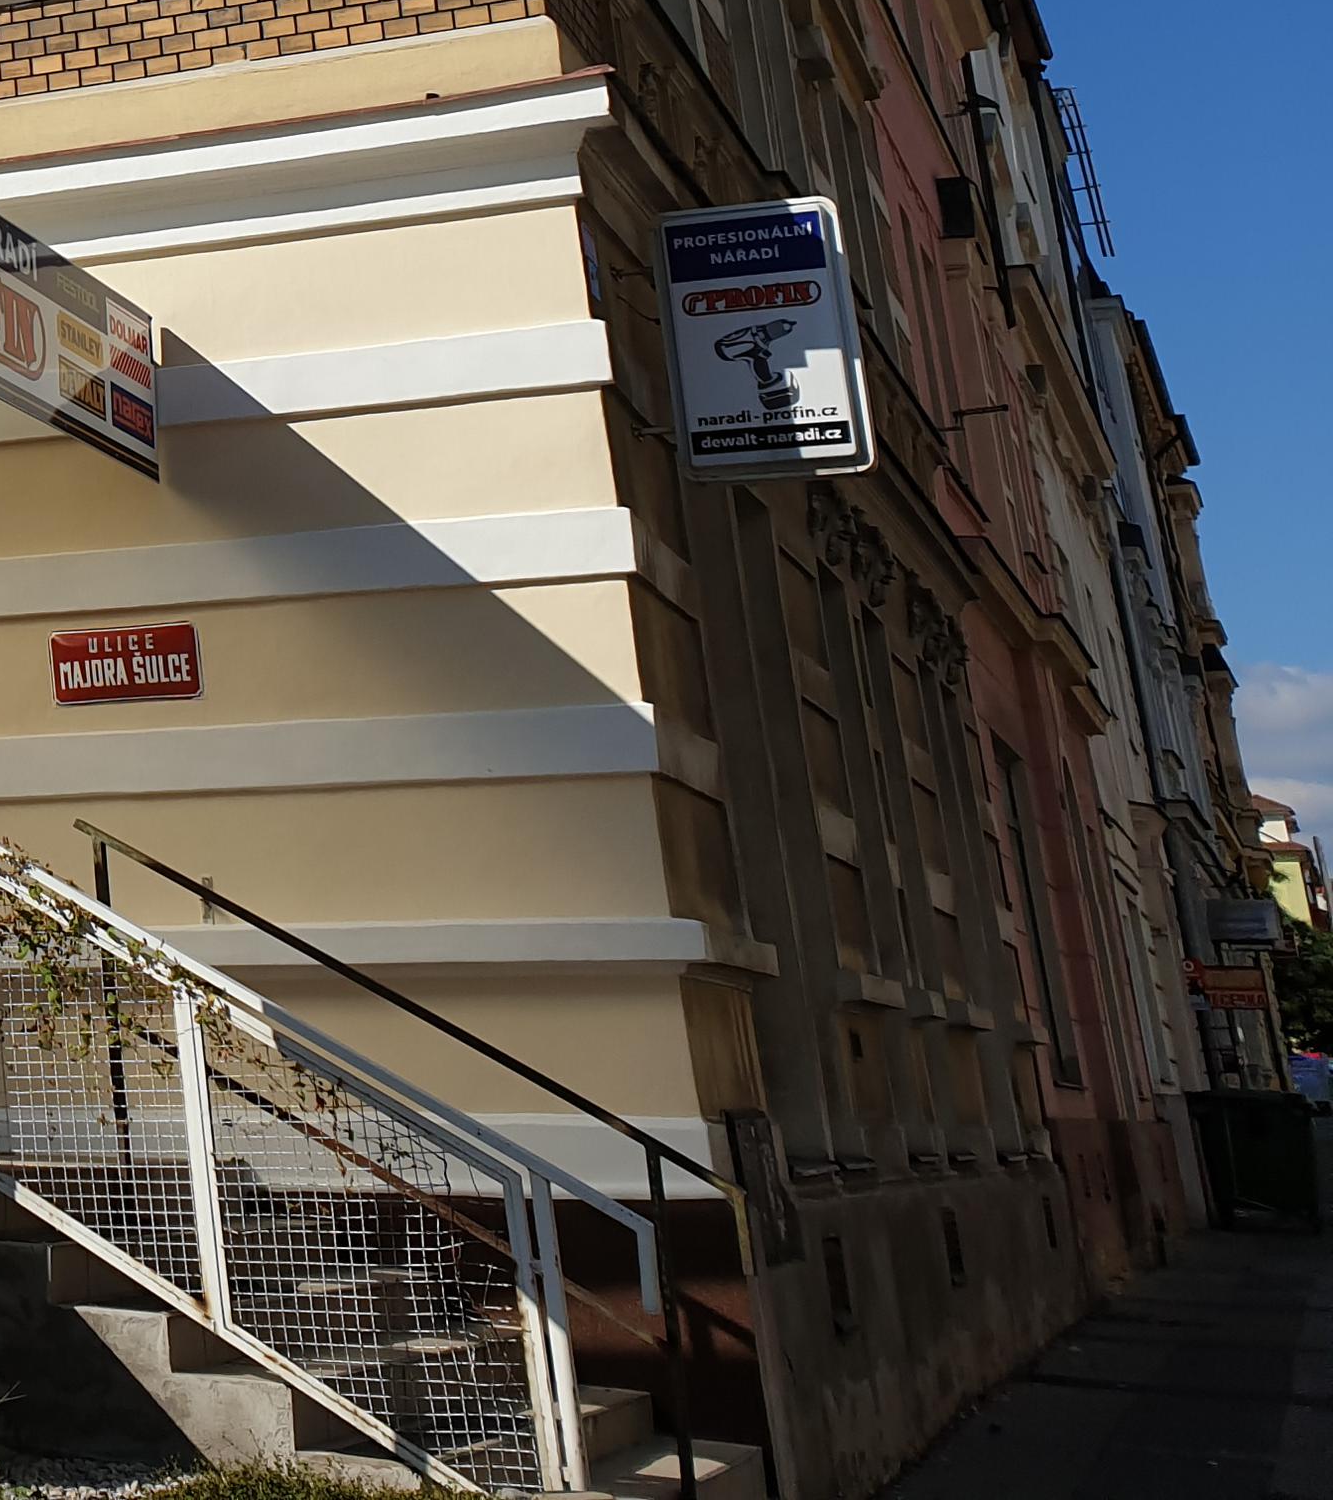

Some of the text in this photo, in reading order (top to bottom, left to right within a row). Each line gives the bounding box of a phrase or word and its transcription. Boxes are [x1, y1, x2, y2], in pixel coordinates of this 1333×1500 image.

[673, 220, 813, 250] PROFESIONÁLNÍ
[702, 281, 813, 311] PROFIN
[60, 319, 102, 360] STANLEY
[109, 314, 149, 356] DOLMAR
[113, 393, 153, 441] narex
[88, 633, 155, 654] ULICE
[59, 651, 192, 691] MAJORA ŠULCE
